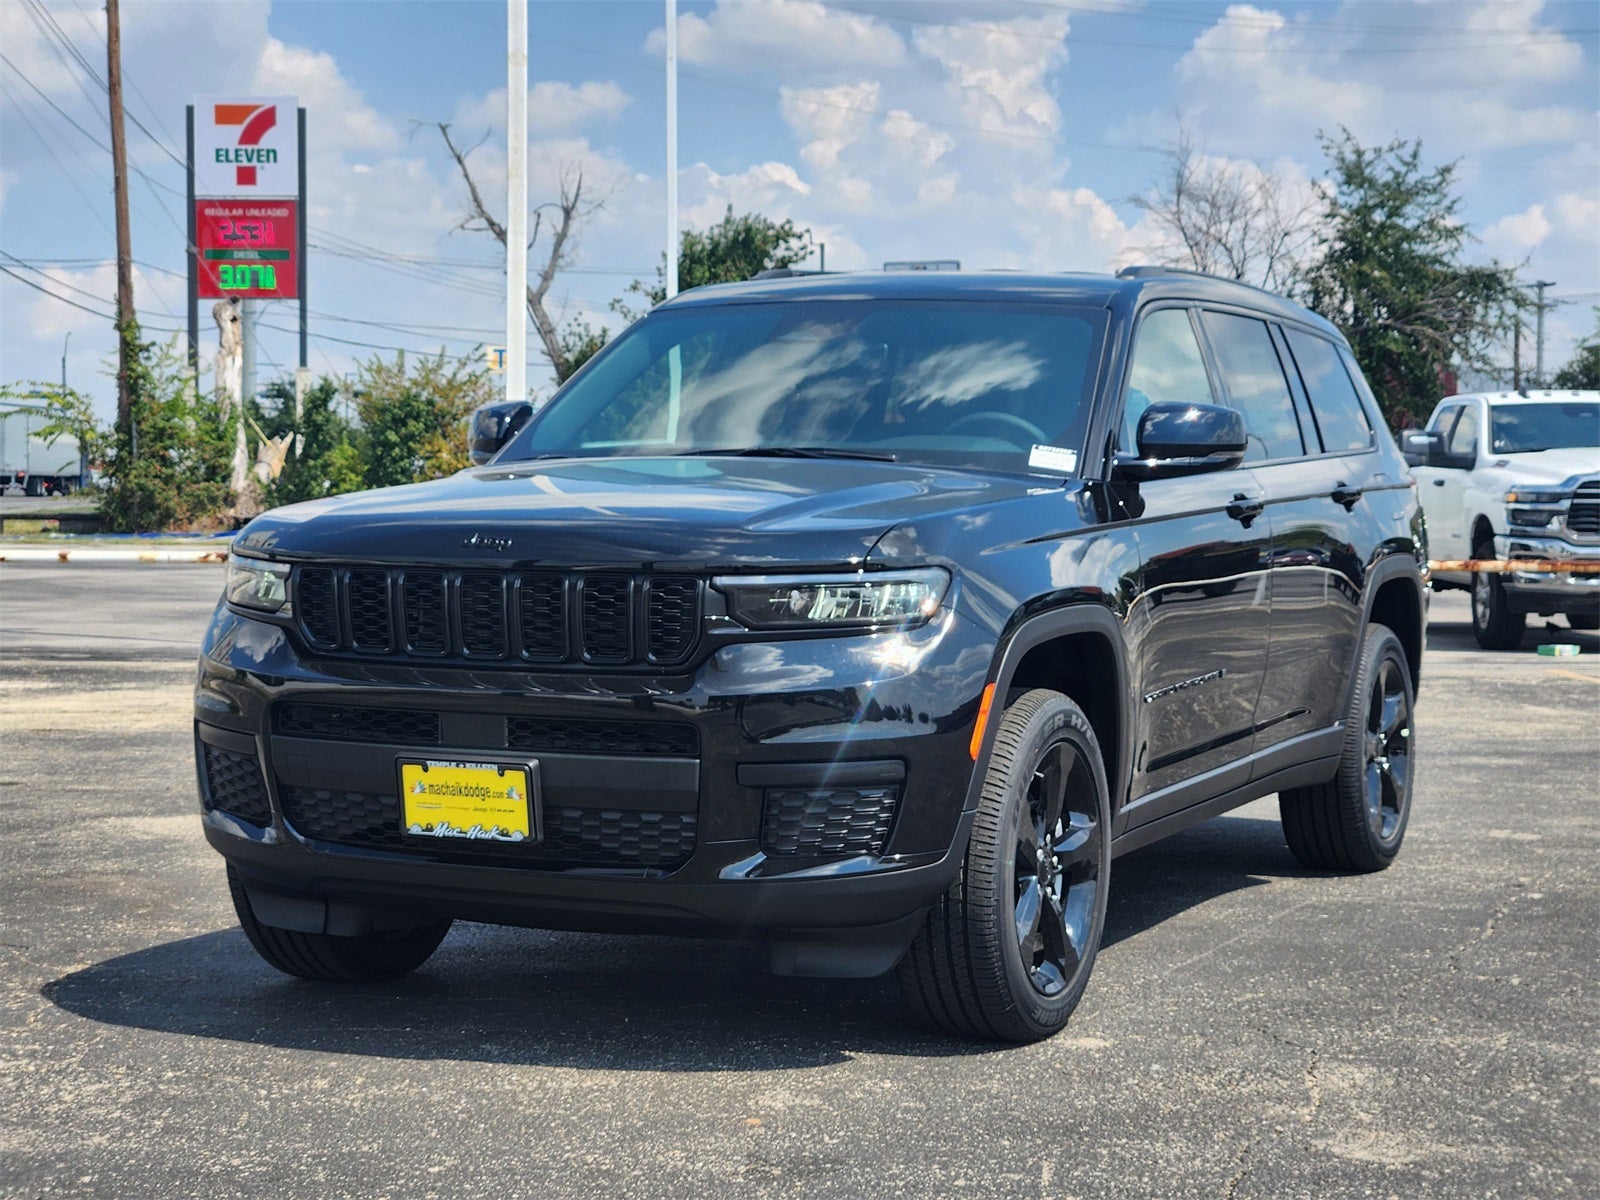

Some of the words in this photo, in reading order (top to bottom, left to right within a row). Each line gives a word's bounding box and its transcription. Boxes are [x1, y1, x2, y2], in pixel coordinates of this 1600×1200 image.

[214, 104, 277, 185] 7
[204, 208, 244, 216] REGULAR
[245, 208, 289, 217] UNLEADED
[428, 781, 504, 801] machaikdodge.com
